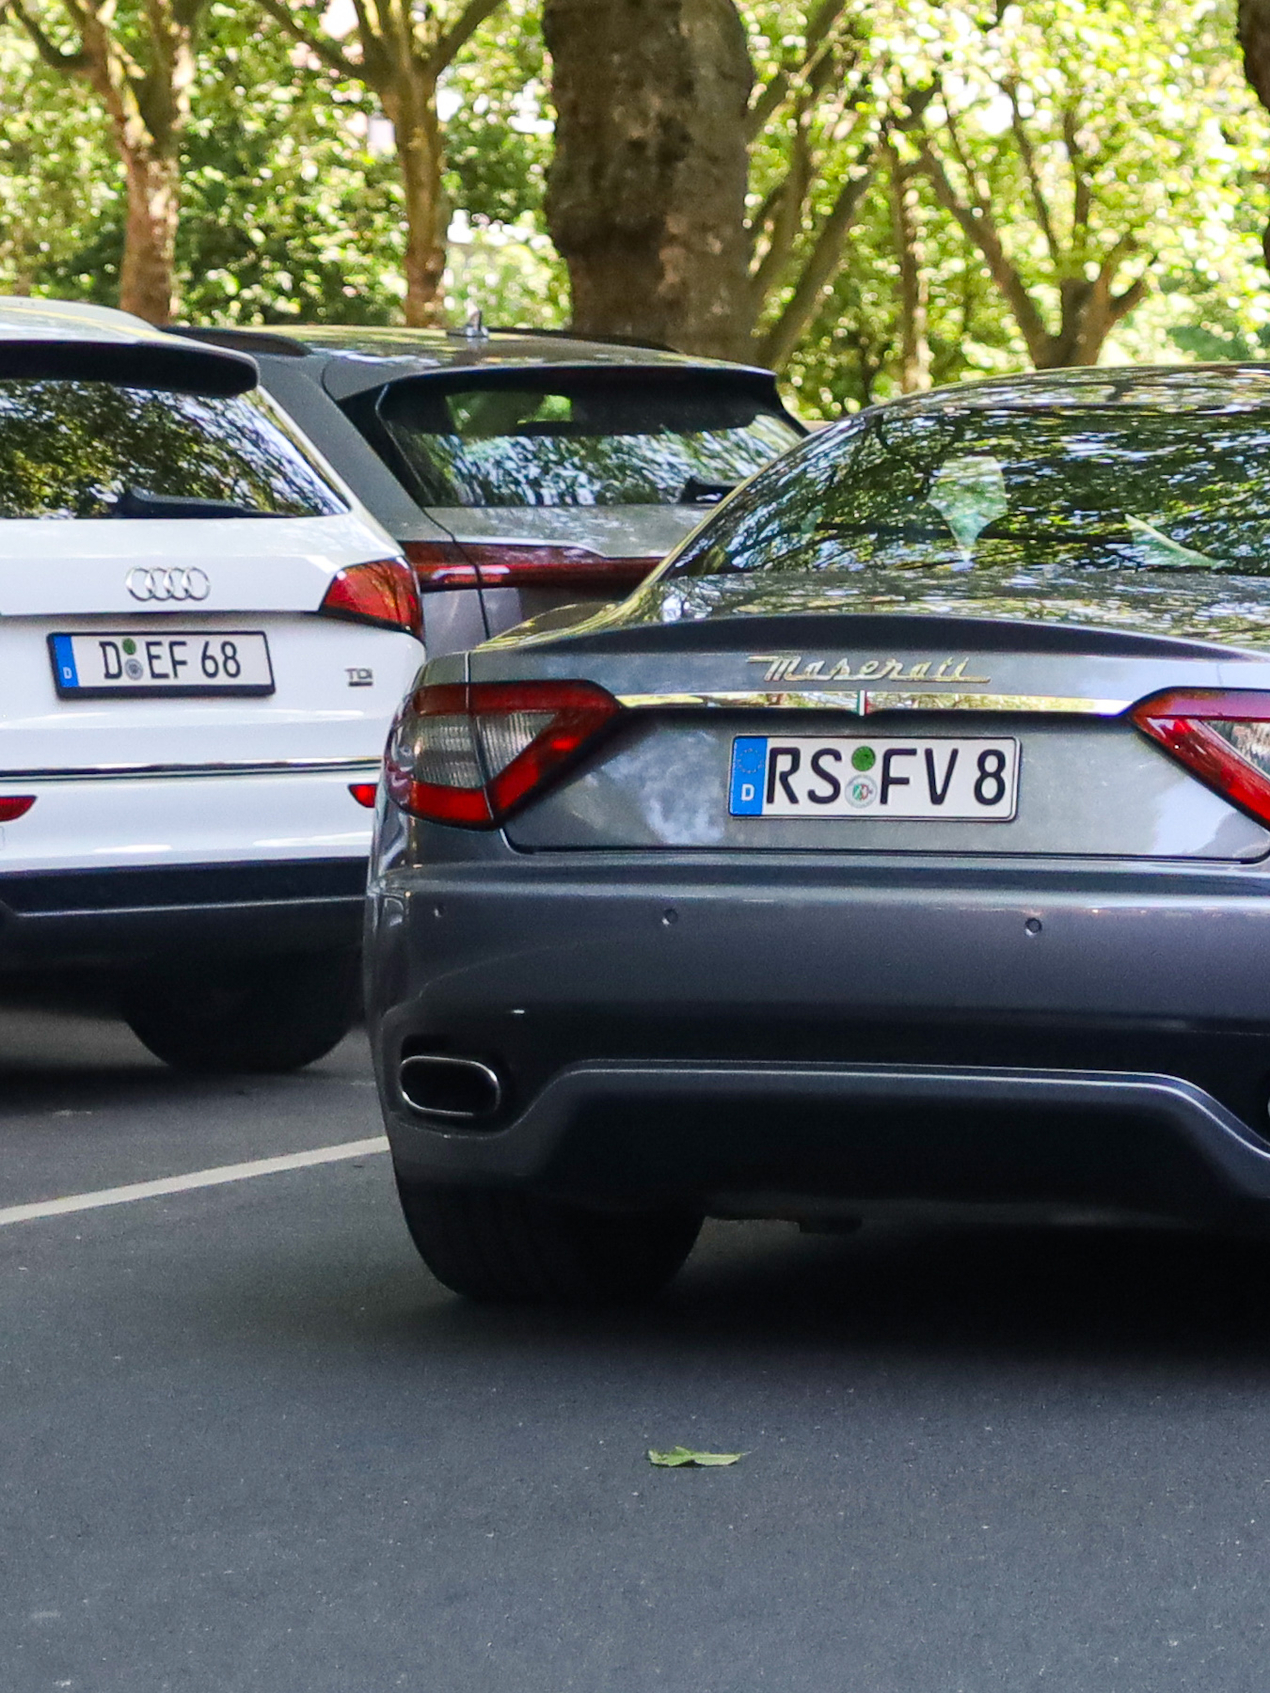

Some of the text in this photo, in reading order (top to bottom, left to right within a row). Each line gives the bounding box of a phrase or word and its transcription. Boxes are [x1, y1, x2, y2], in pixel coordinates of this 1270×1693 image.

[63, 641, 241, 679] D D EF 68
[746, 656, 991, 684] Maserati
[741, 747, 1006, 806] D RS FV 8
